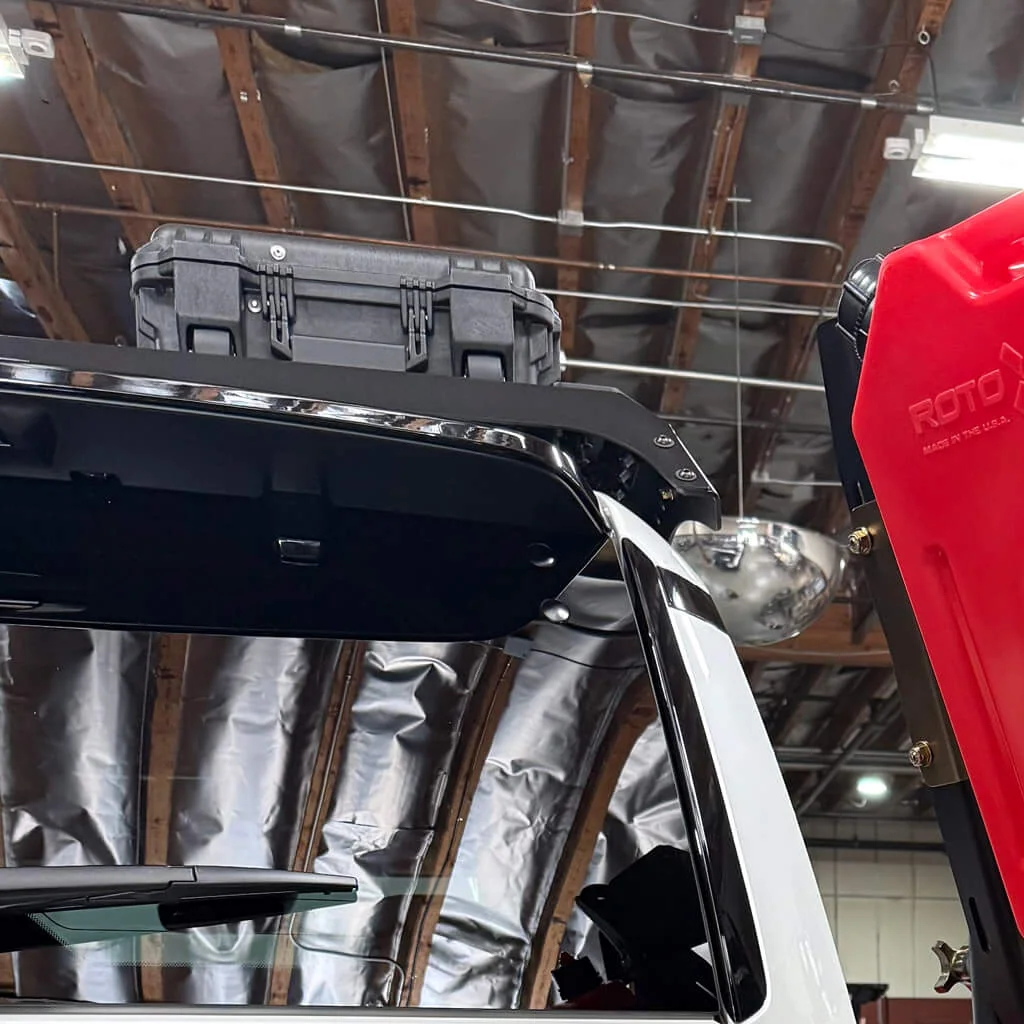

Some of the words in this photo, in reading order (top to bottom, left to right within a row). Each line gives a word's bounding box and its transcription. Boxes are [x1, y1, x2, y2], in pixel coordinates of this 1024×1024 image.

[908, 369, 1005, 434] ROTO
[923, 438, 950, 455] MADE
[962, 425, 981, 439] THE
